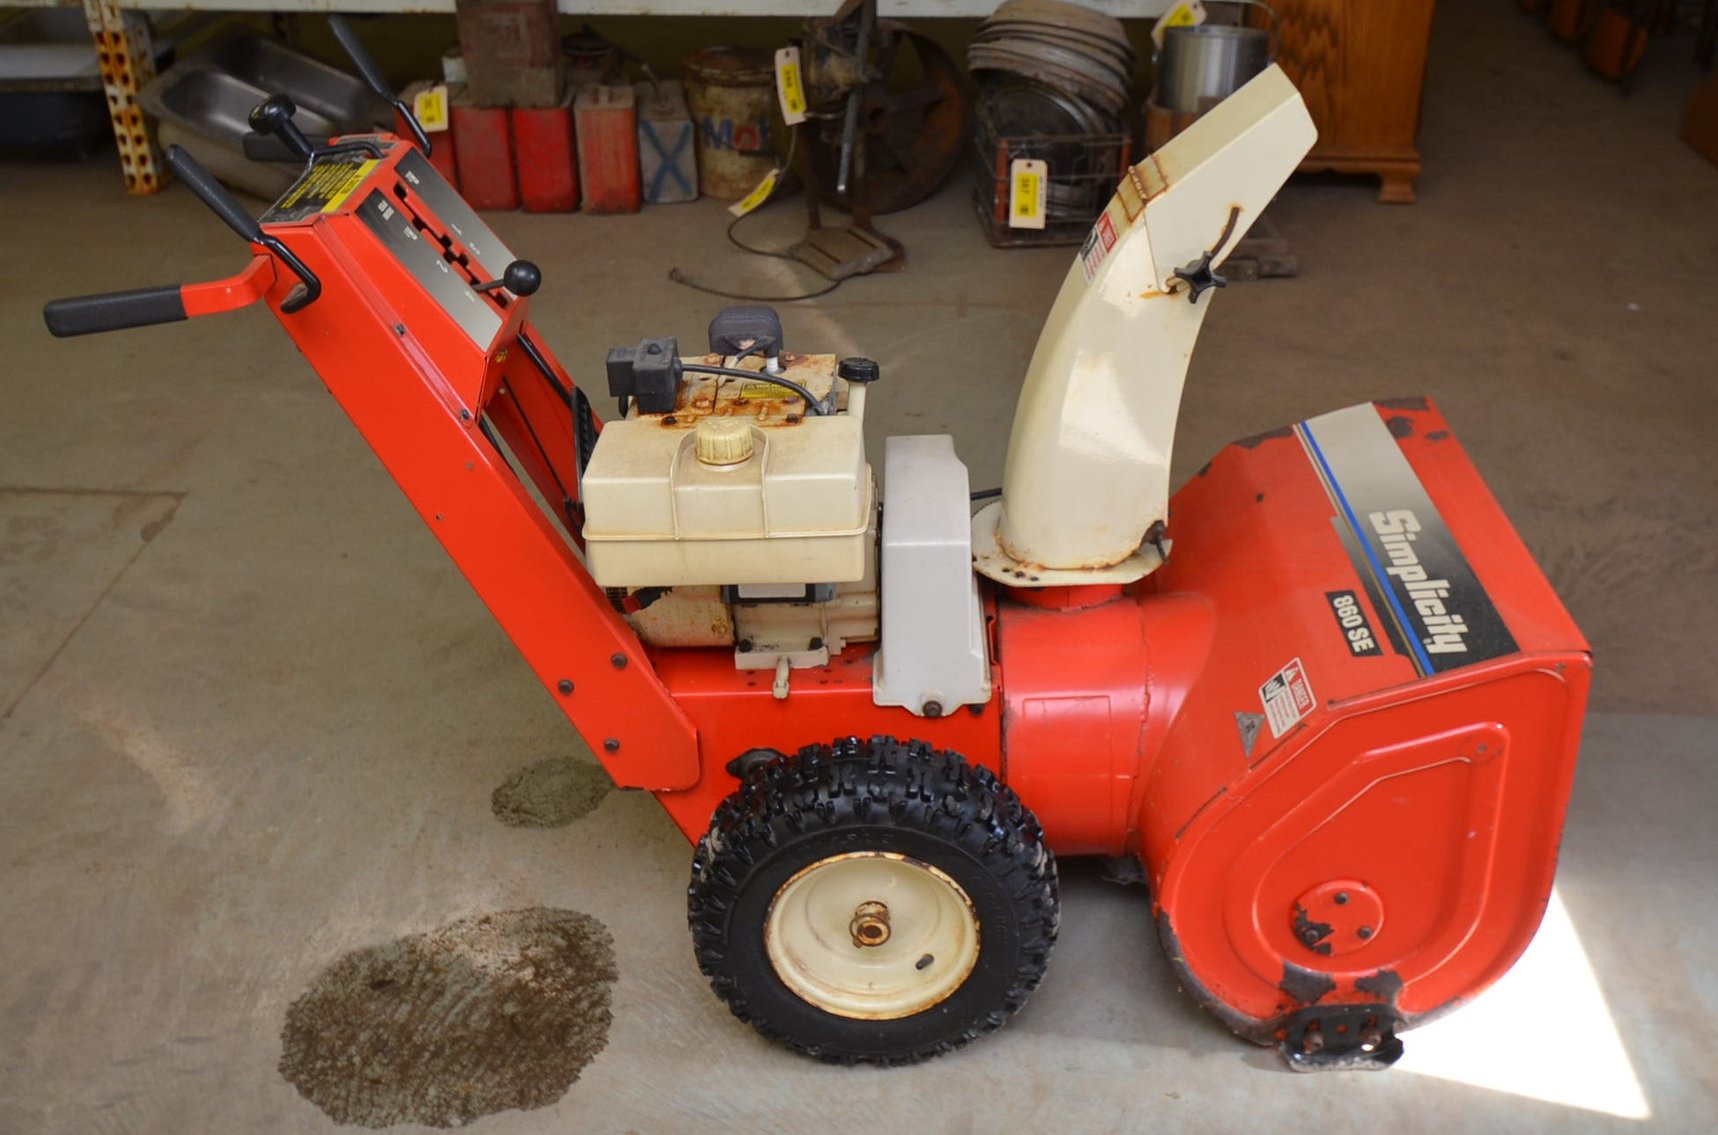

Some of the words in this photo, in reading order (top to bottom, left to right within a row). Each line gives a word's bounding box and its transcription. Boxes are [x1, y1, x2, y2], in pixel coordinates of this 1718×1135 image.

[1368, 509, 1469, 654] Simplicity
[1333, 594, 1363, 629] 860
[1347, 627, 1375, 653] SE
